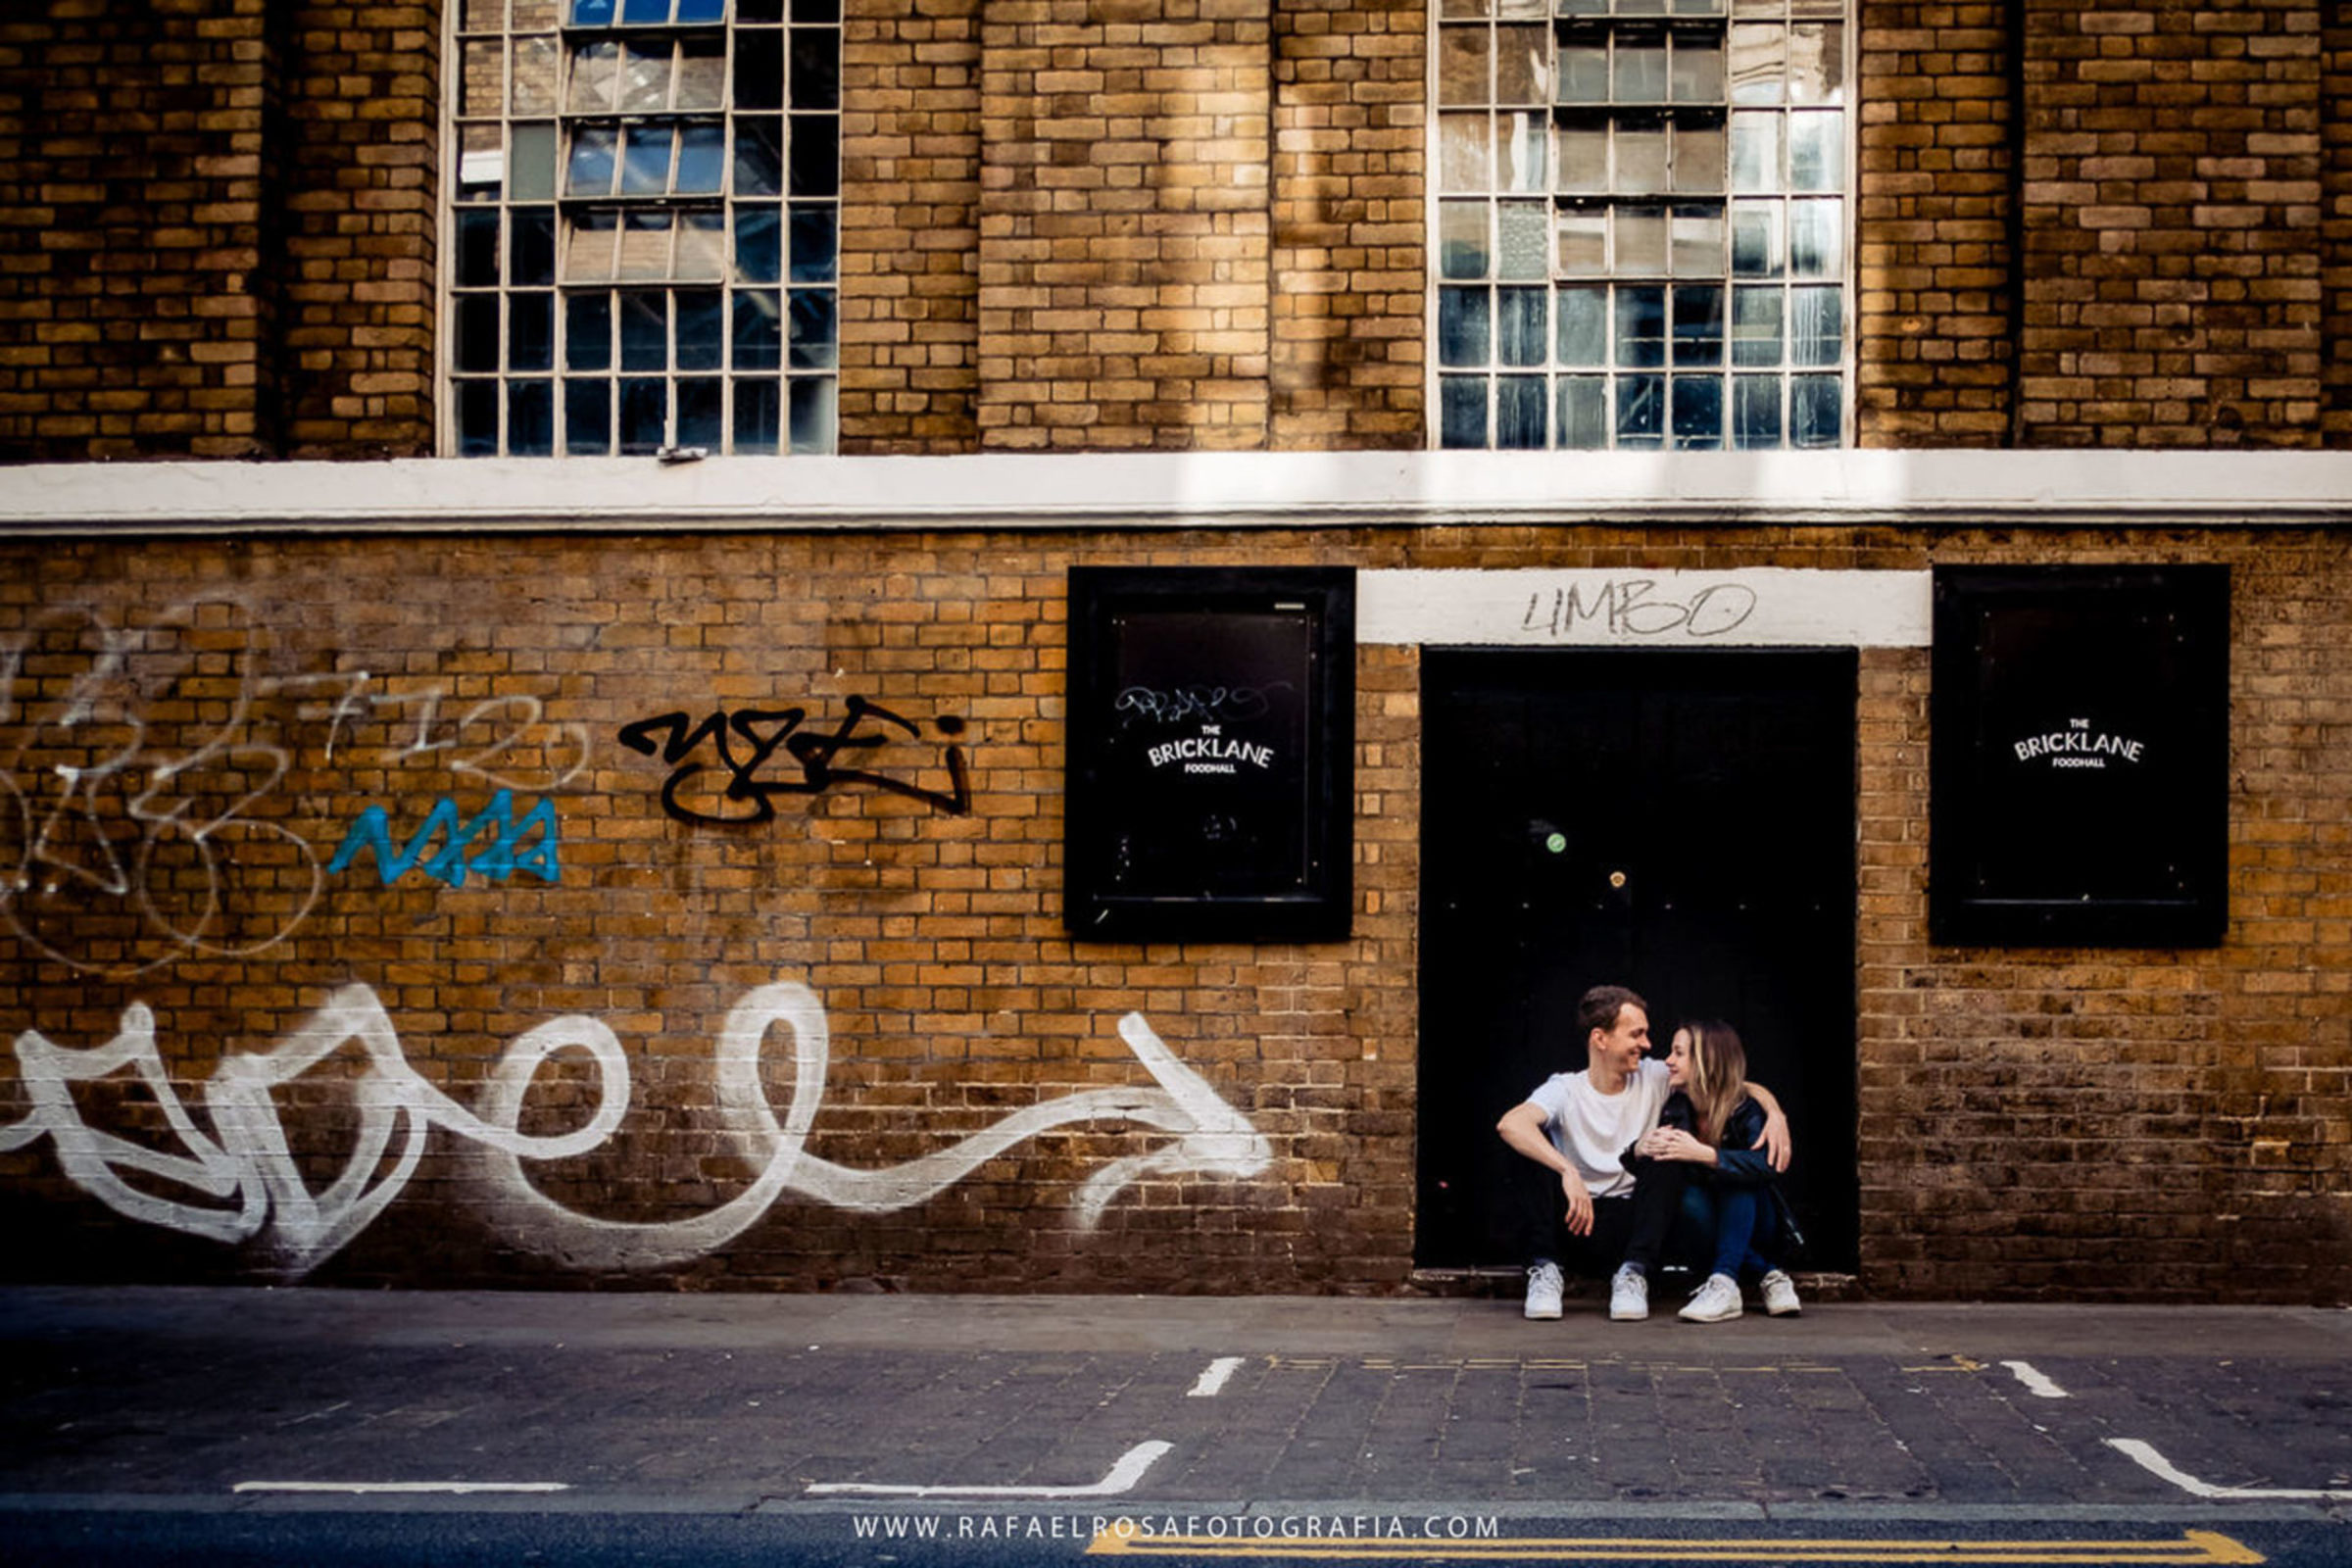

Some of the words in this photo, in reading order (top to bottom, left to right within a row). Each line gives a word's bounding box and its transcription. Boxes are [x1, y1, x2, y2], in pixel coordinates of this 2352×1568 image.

[2070, 717, 2089, 729] THE
[1201, 724, 1221, 736] THE
[2014, 731, 2144, 762] BRICKLANE
[1148, 738, 1274, 768] BRICKLANE
[1184, 762, 1236, 774] FOODHALL
[2052, 757, 2105, 767] FOODHALL
